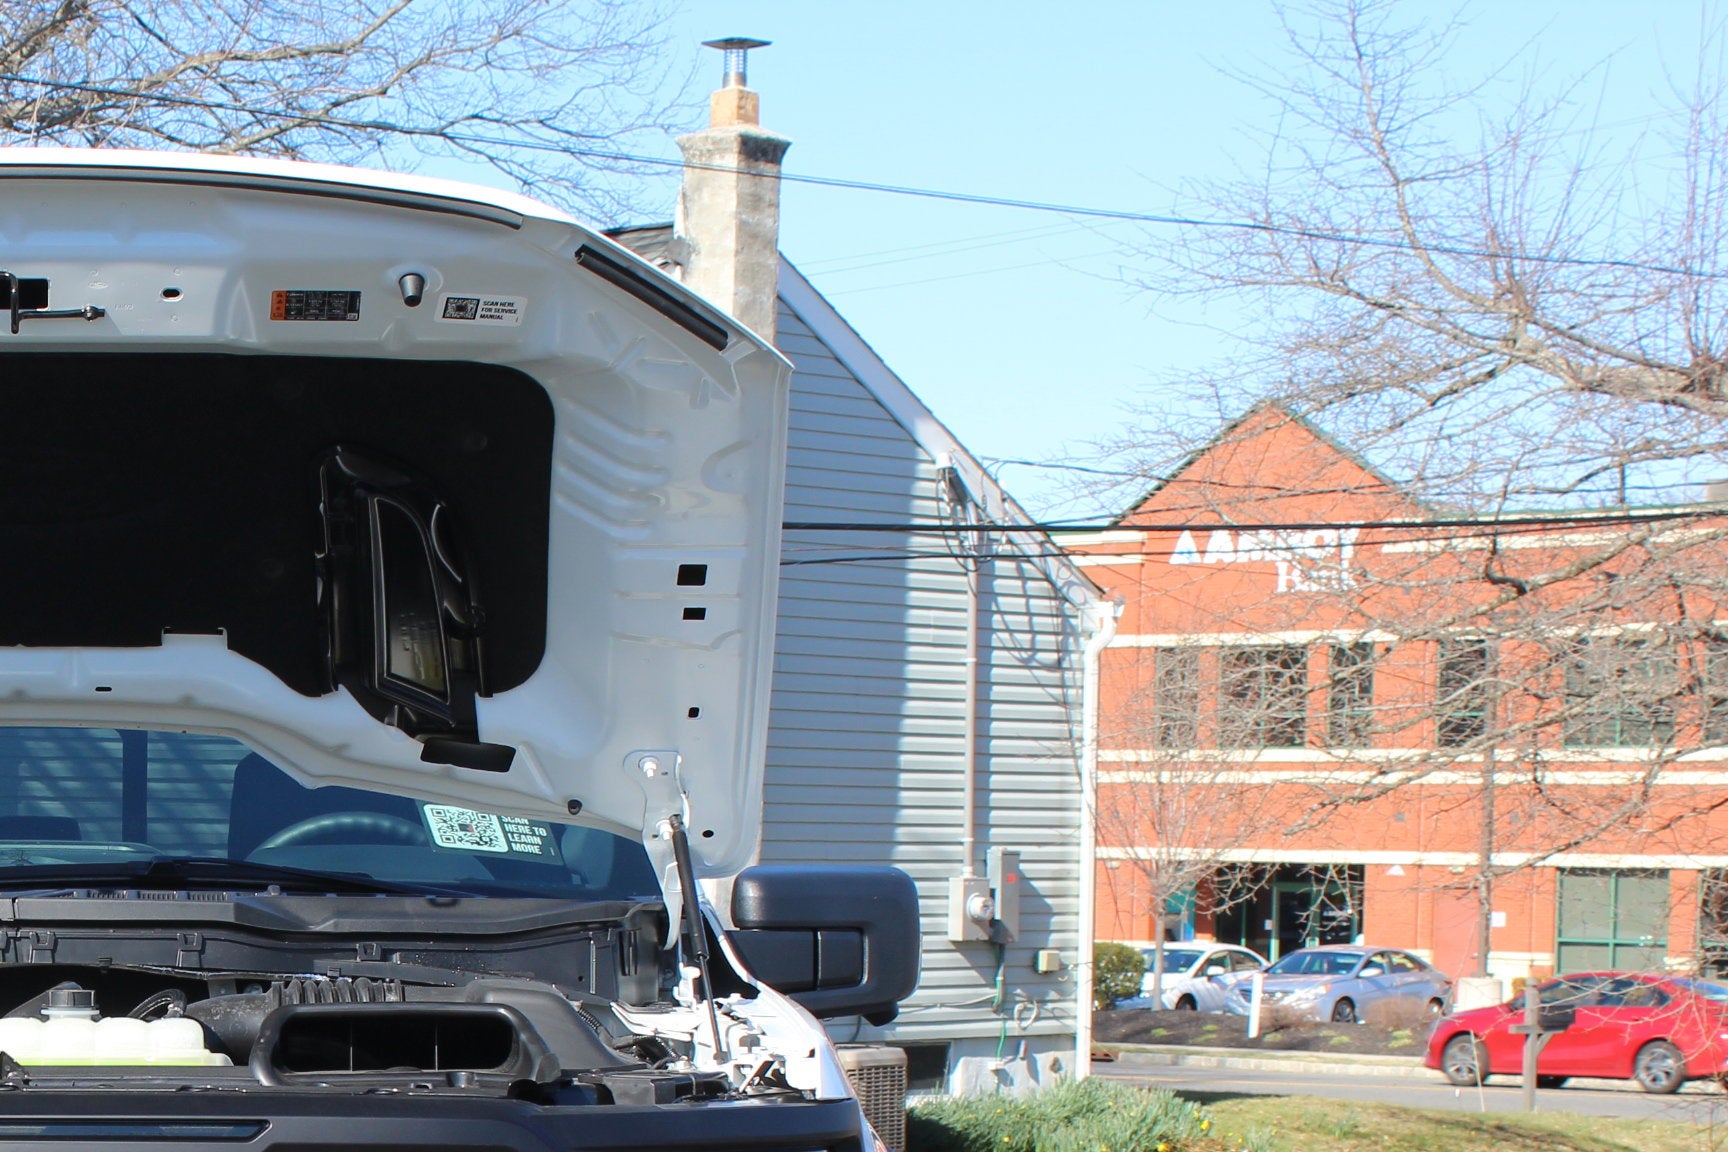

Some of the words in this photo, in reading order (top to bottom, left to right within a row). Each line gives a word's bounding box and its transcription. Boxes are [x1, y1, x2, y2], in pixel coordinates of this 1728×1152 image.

[504, 823, 532, 835] HERE
[532, 826, 547, 837] TO
[507, 833, 542, 845] LEARN
[511, 843, 542, 855] MORE
